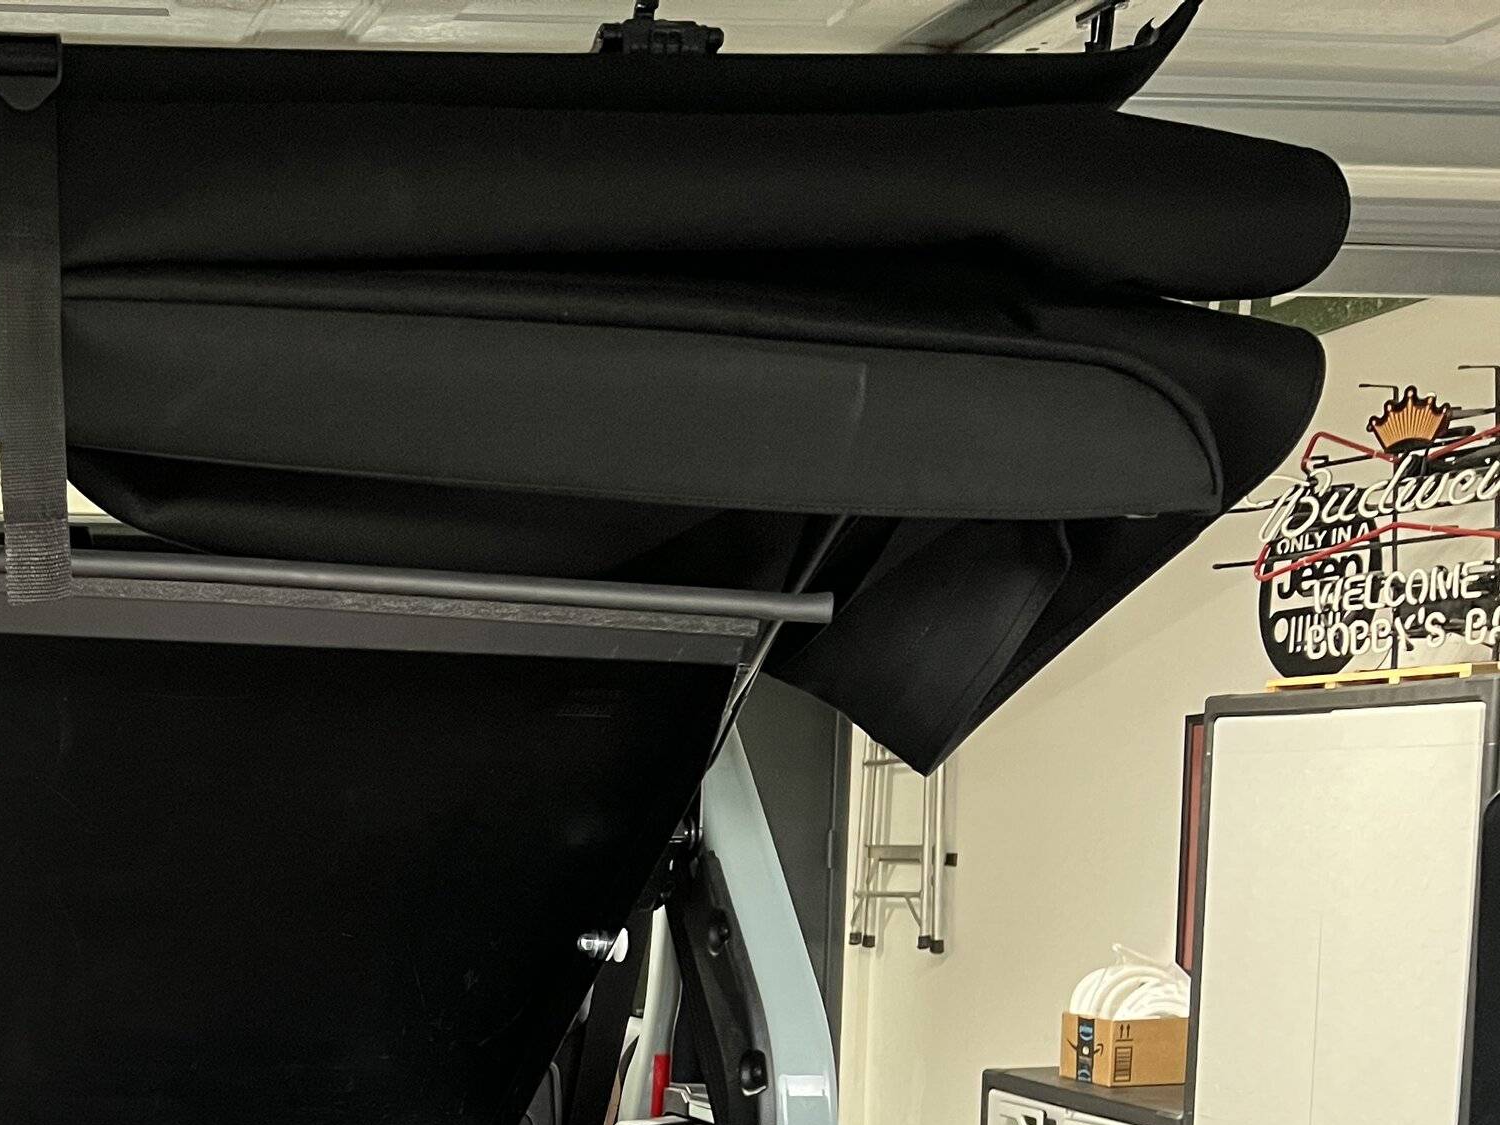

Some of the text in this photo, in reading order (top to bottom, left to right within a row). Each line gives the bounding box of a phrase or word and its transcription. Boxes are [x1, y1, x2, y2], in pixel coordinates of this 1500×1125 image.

[1276, 530, 1327, 555] ONLY
[1330, 524, 1354, 546] IN
[1311, 560, 1484, 615] WELCOME
